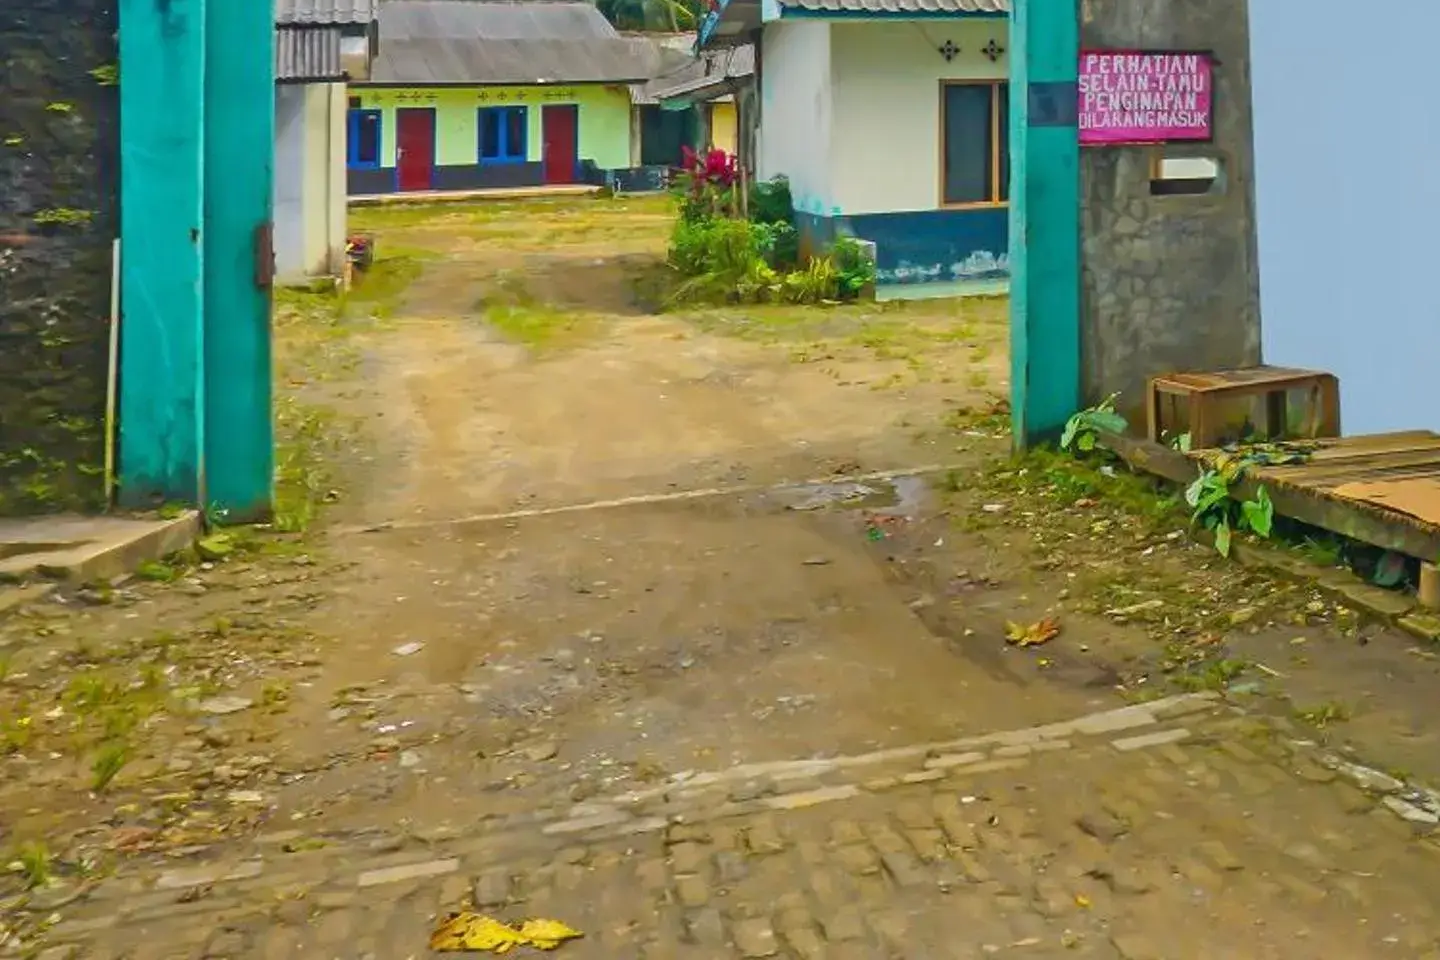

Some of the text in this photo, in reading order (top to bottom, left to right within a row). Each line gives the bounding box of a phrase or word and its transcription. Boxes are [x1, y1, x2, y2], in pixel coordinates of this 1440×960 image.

[1085, 53, 1197, 74] PERHATIAN
[1084, 91, 1197, 111] PENGINAPAN
[1156, 111, 1208, 128] MASUK
